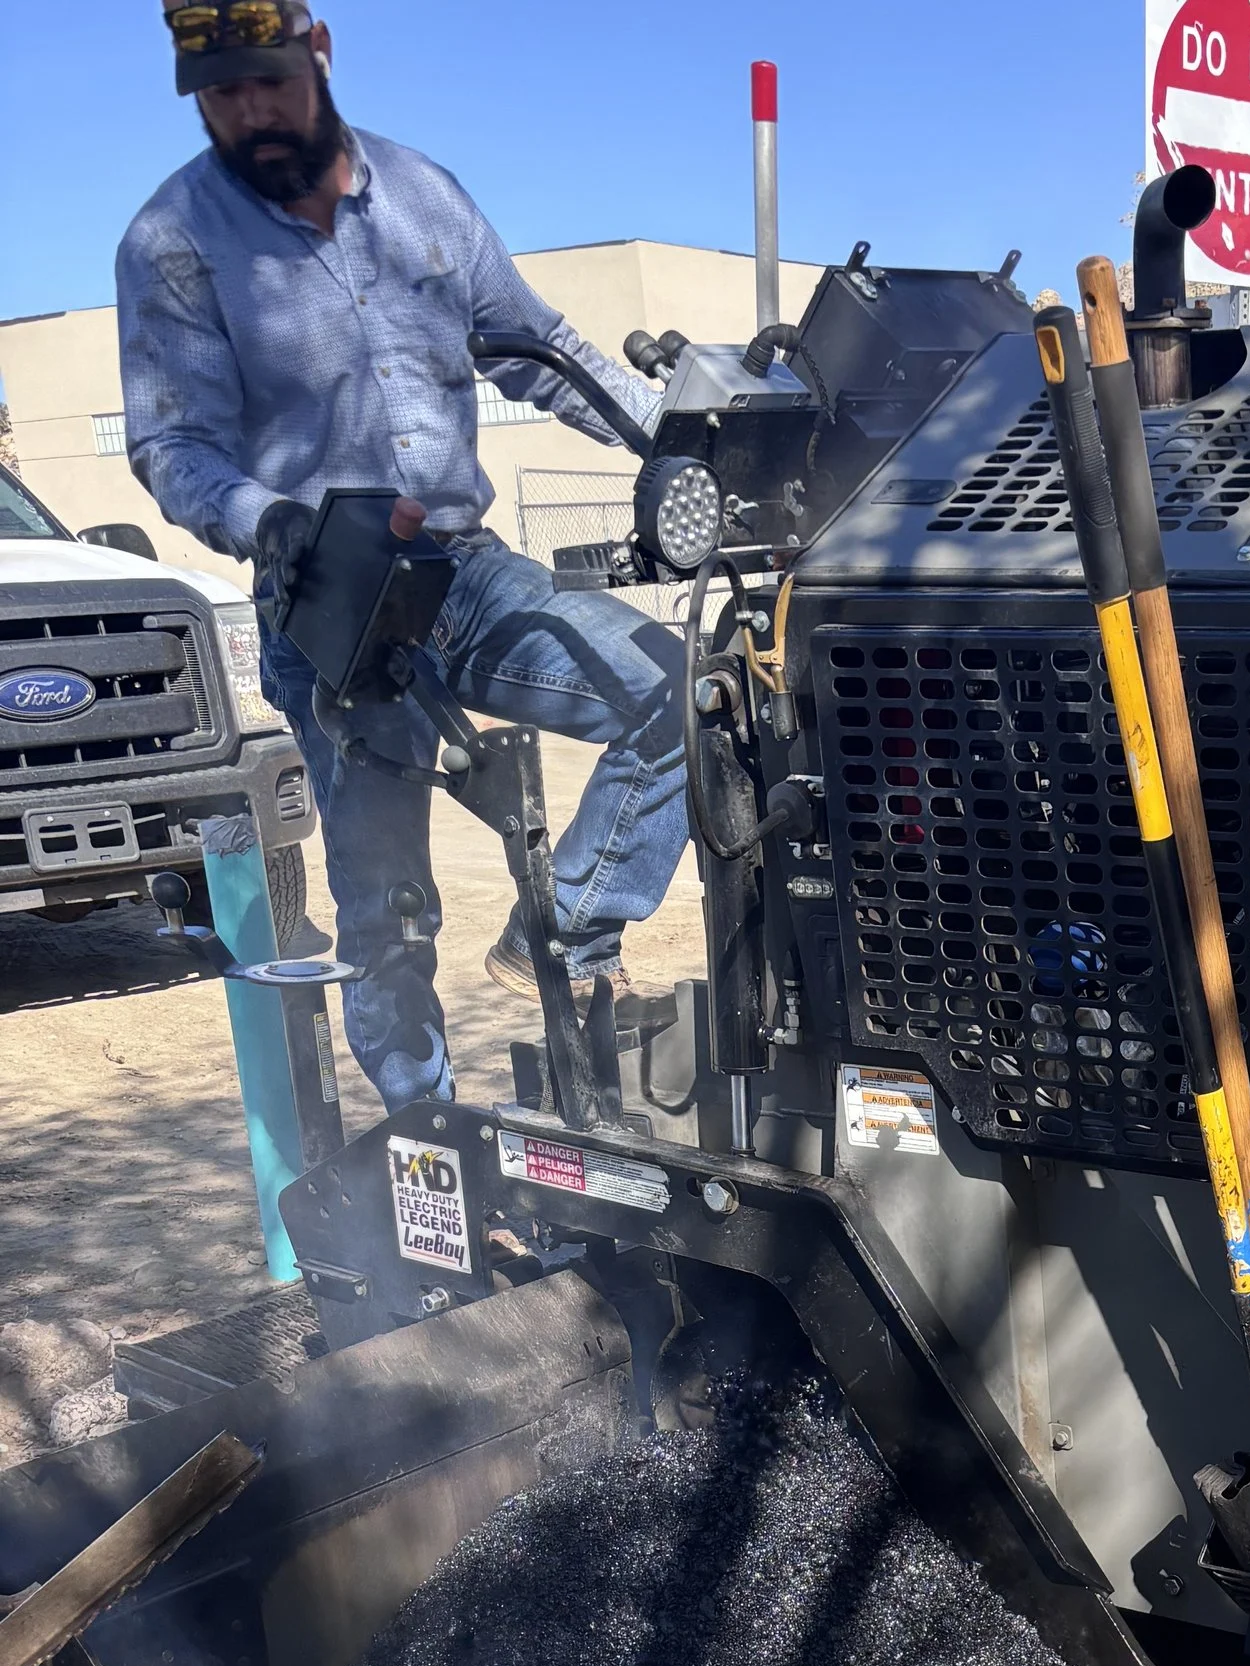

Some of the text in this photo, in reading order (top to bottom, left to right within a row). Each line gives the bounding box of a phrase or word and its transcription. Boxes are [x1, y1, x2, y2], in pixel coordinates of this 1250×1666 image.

[1182, 23, 1226, 77] DO
[15, 680, 72, 708] Ford
[882, 1072, 914, 1082] WARNING
[537, 1143, 580, 1162] DANGER
[538, 1156, 583, 1176] PELIGRO
[539, 1168, 583, 1189] DANGER
[397, 1185, 460, 1208] HEAVY DUTY
[398, 1196, 461, 1222] ELECTRIC
[400, 1209, 463, 1237] LEGEND
[403, 1226, 465, 1267] LeeBoy
